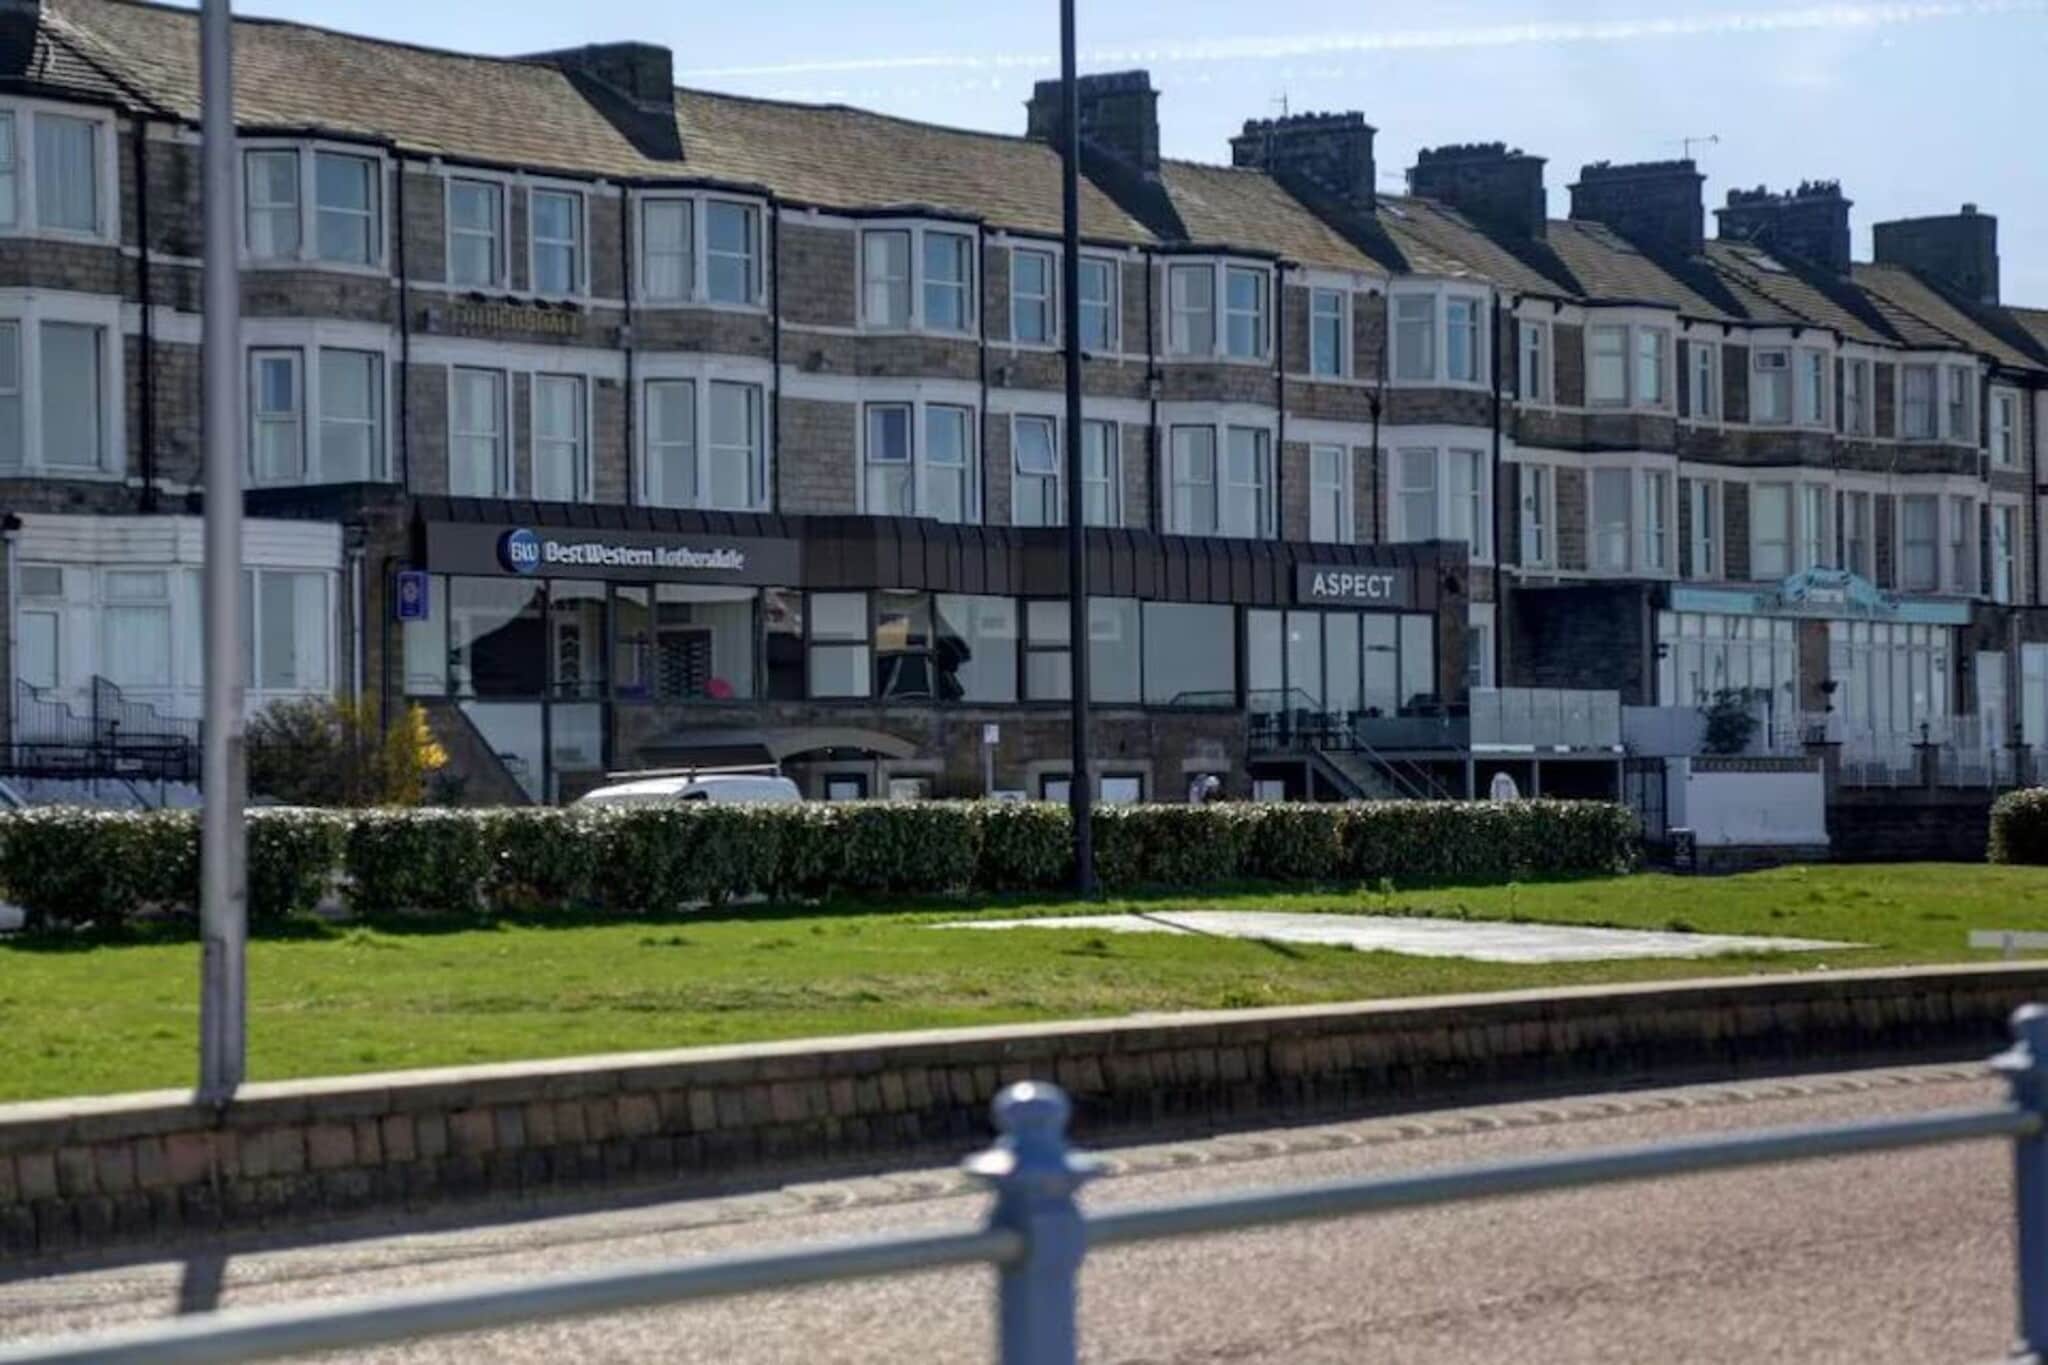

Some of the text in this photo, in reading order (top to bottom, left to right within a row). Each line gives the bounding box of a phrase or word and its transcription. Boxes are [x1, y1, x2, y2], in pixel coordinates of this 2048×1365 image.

[544, 541, 584, 563] Best
[585, 543, 654, 567] Western
[1312, 571, 1395, 599] ASPECT
